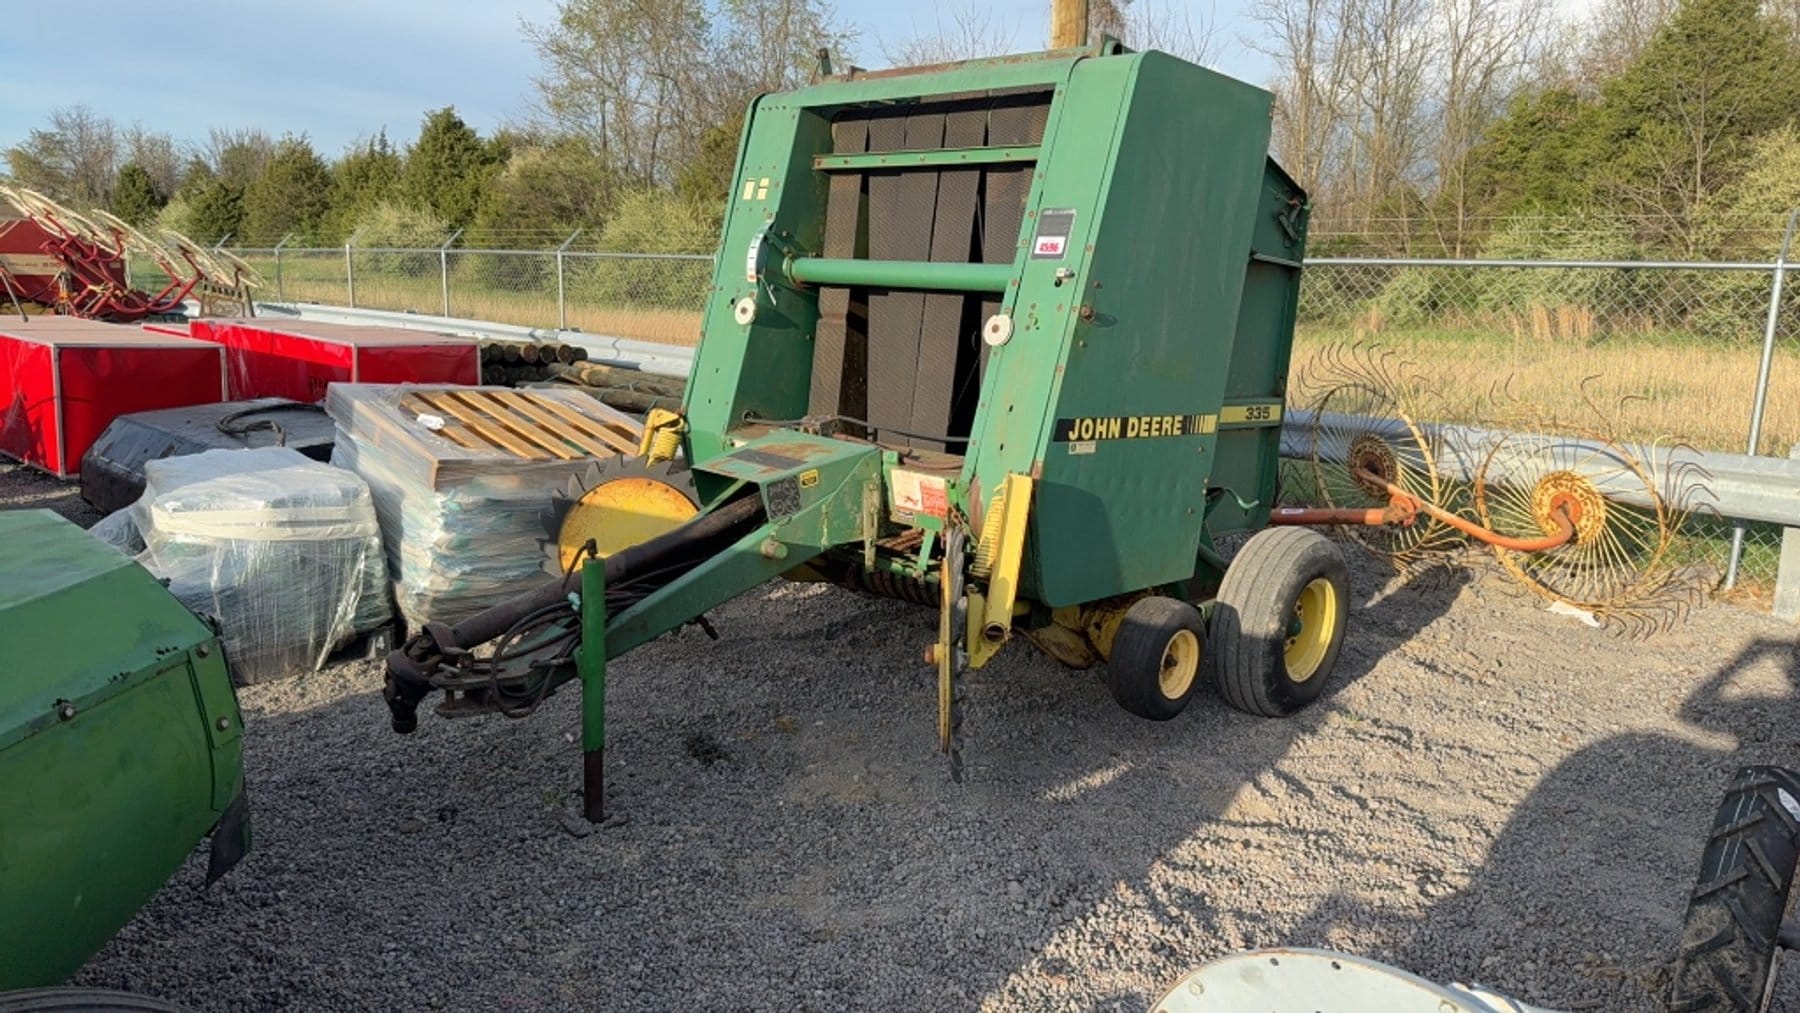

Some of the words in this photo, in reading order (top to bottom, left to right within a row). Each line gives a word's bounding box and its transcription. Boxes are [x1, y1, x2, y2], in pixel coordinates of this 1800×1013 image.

[1245, 406, 1271, 420] 335
[1068, 417, 1121, 441] JOHN
[1126, 415, 1183, 438] DEERE
